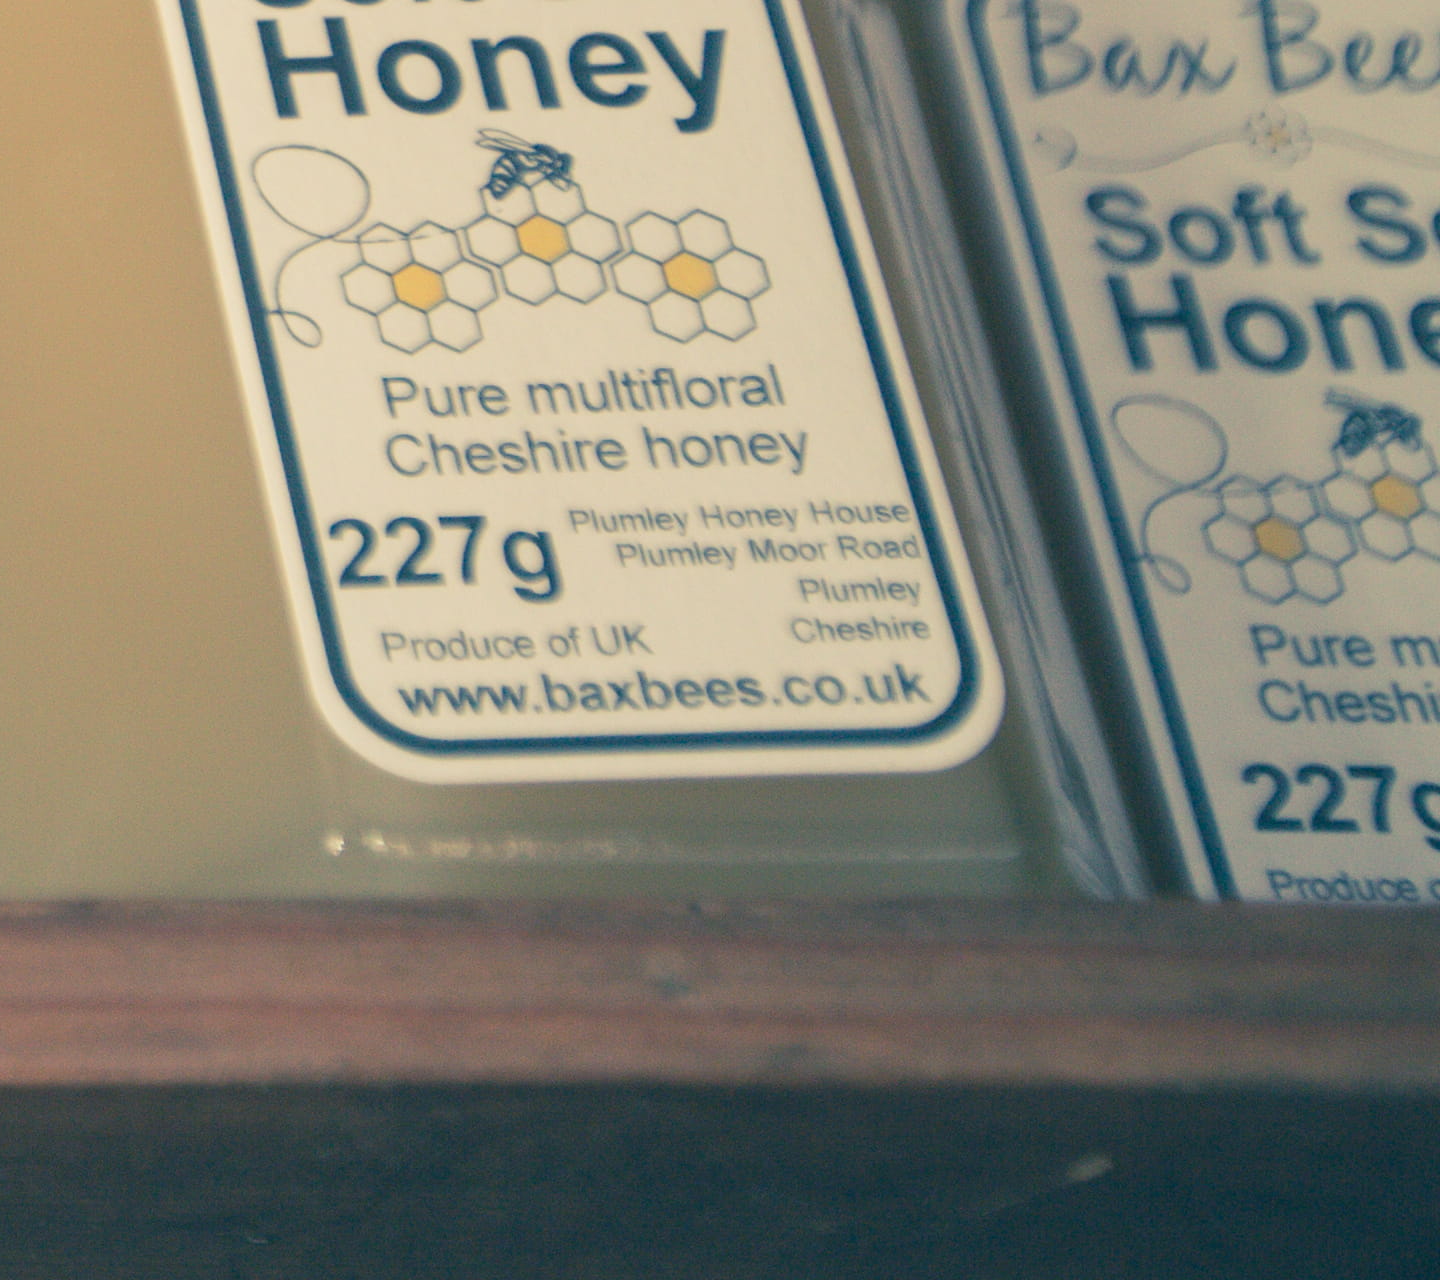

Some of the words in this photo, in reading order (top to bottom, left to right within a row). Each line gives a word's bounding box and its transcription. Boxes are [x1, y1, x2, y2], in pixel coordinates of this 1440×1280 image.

[256, 17, 726, 134] Honey
[1083, 184, 1319, 269] Soft
[380, 376, 509, 418] Pure
[526, 363, 785, 413] multifloral
[385, 430, 627, 477] Cheshire
[641, 426, 807, 475] honey
[567, 508, 688, 536] Plumley
[698, 505, 797, 531] Honey
[808, 493, 916, 526] House
[328, 515, 562, 603] 227g
[615, 542, 736, 569] Plumley
[746, 538, 824, 562] Moor
[836, 534, 922, 559] Road
[797, 577, 920, 606] Plumley
[379, 630, 535, 661] Produce
[546, 626, 579, 658] of
[590, 625, 651, 656] UK
[790, 616, 929, 643] Cheshire
[1248, 623, 1375, 668] Pure
[398, 662, 930, 715] www.baxbees.co.uk
[1268, 869, 1425, 904] Produce
